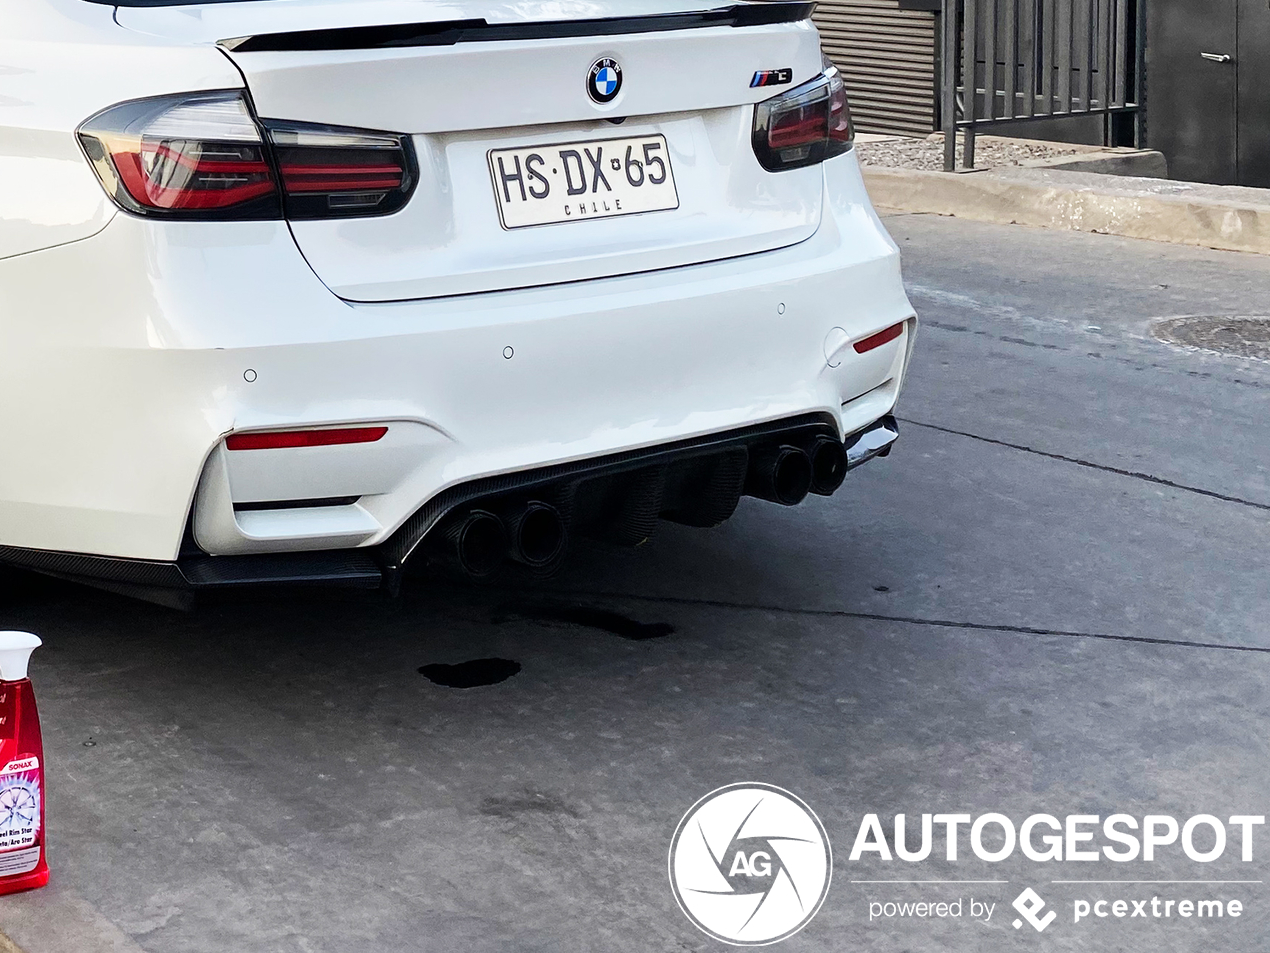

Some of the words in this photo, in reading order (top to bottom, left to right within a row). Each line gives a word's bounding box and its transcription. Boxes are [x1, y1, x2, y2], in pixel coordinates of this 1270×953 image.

[564, 199, 623, 216] CHILE
[8, 761, 33, 771] SONAX
[21, 827, 33, 835] Star
